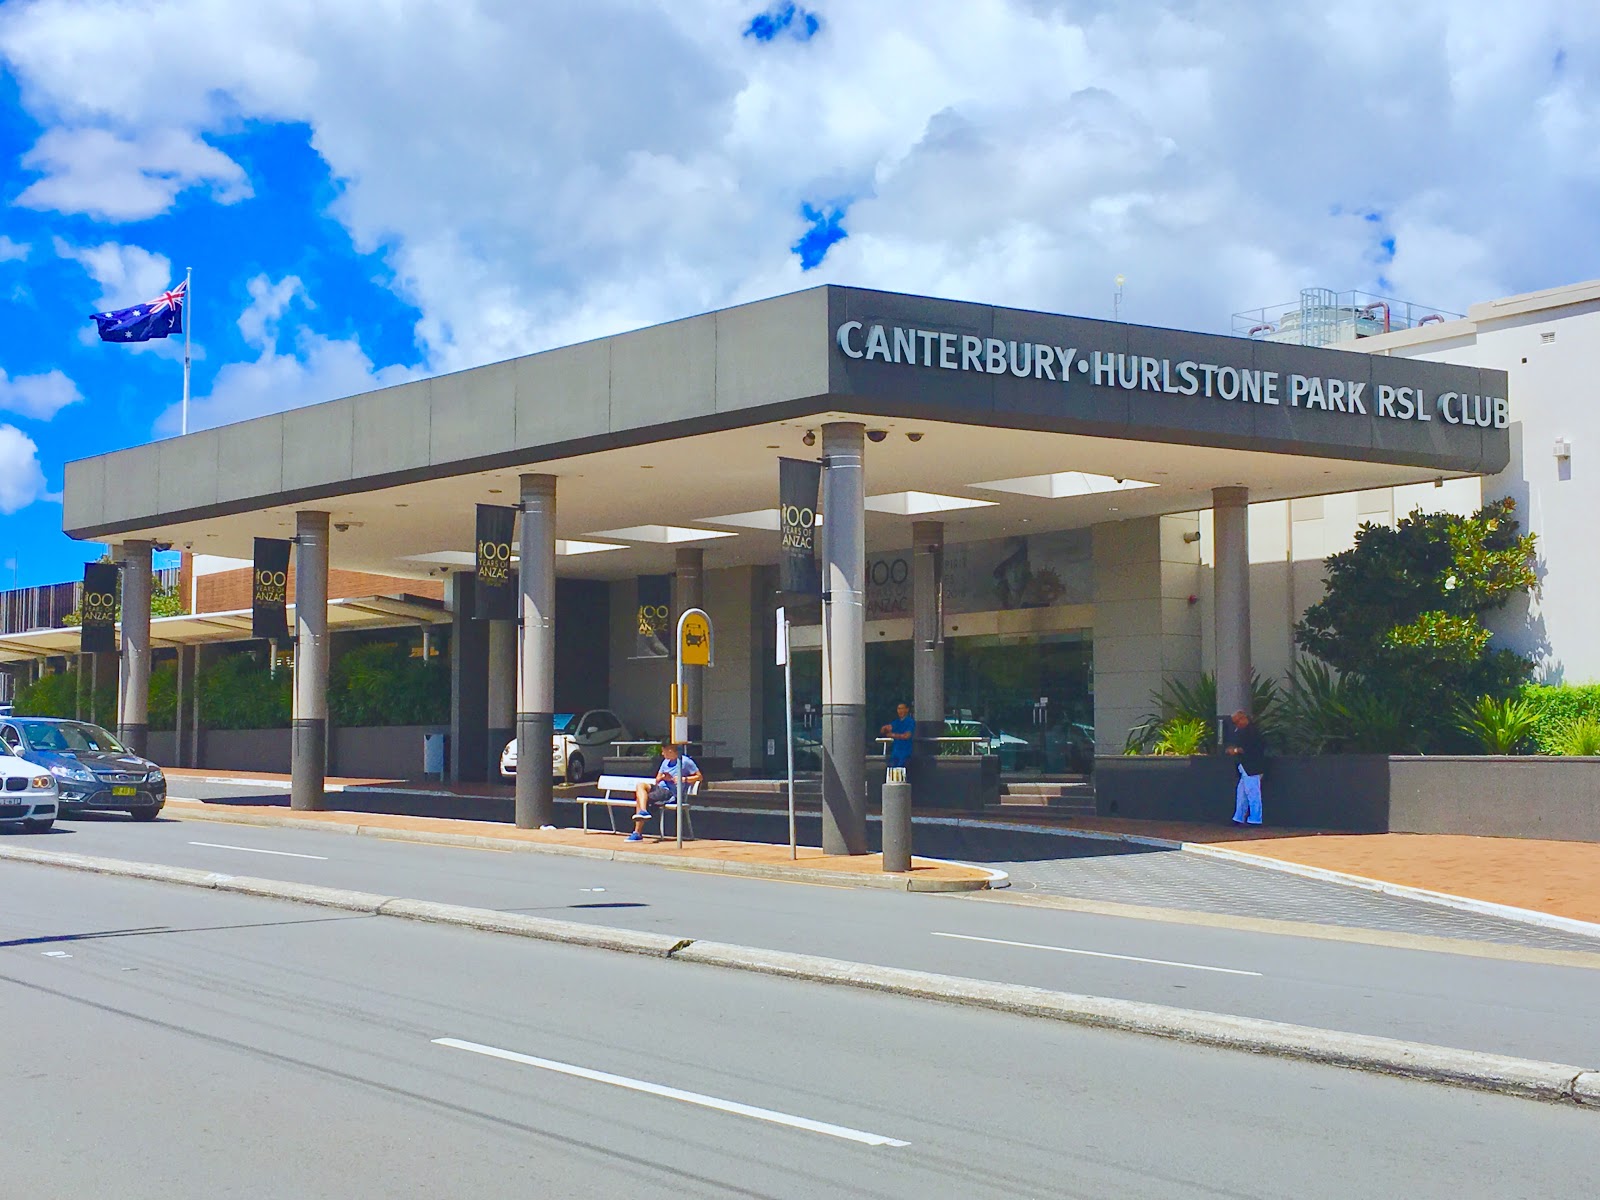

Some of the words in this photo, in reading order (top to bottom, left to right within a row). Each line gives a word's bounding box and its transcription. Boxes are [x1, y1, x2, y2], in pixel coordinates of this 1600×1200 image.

[1287, 374, 1367, 415] PARK
[1378, 385, 1431, 421] RSL
[1437, 392, 1510, 429] CLUB
[782, 503, 813, 528] 100
[782, 526, 802, 536] YEARS
[782, 534, 812, 549] ANZAC
[478, 540, 510, 560] 100
[255, 568, 286, 586] 100
[478, 567, 508, 579] ANZAC
[84, 592, 114, 606] 100
[256, 592, 284, 602] ANZAC
[84, 612, 113, 621] ANZAC
[638, 605, 668, 618] 100
